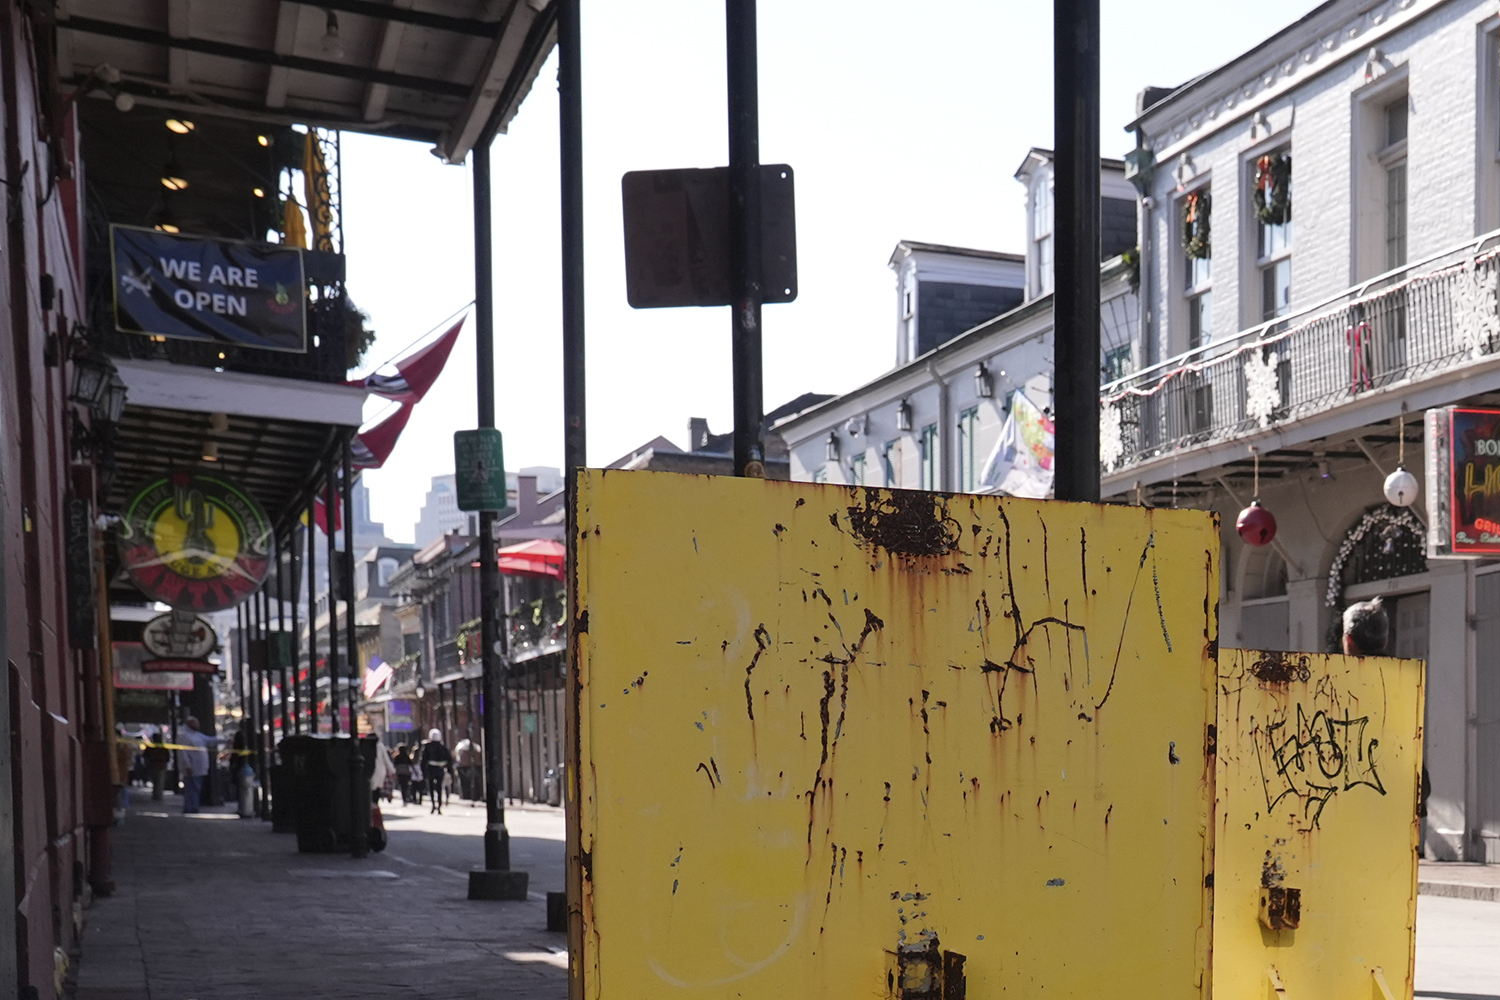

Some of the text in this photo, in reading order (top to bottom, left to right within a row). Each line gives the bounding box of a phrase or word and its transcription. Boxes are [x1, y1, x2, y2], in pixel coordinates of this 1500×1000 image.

[159, 257, 258, 288] WE ARE
[174, 289, 247, 316] OPEN
